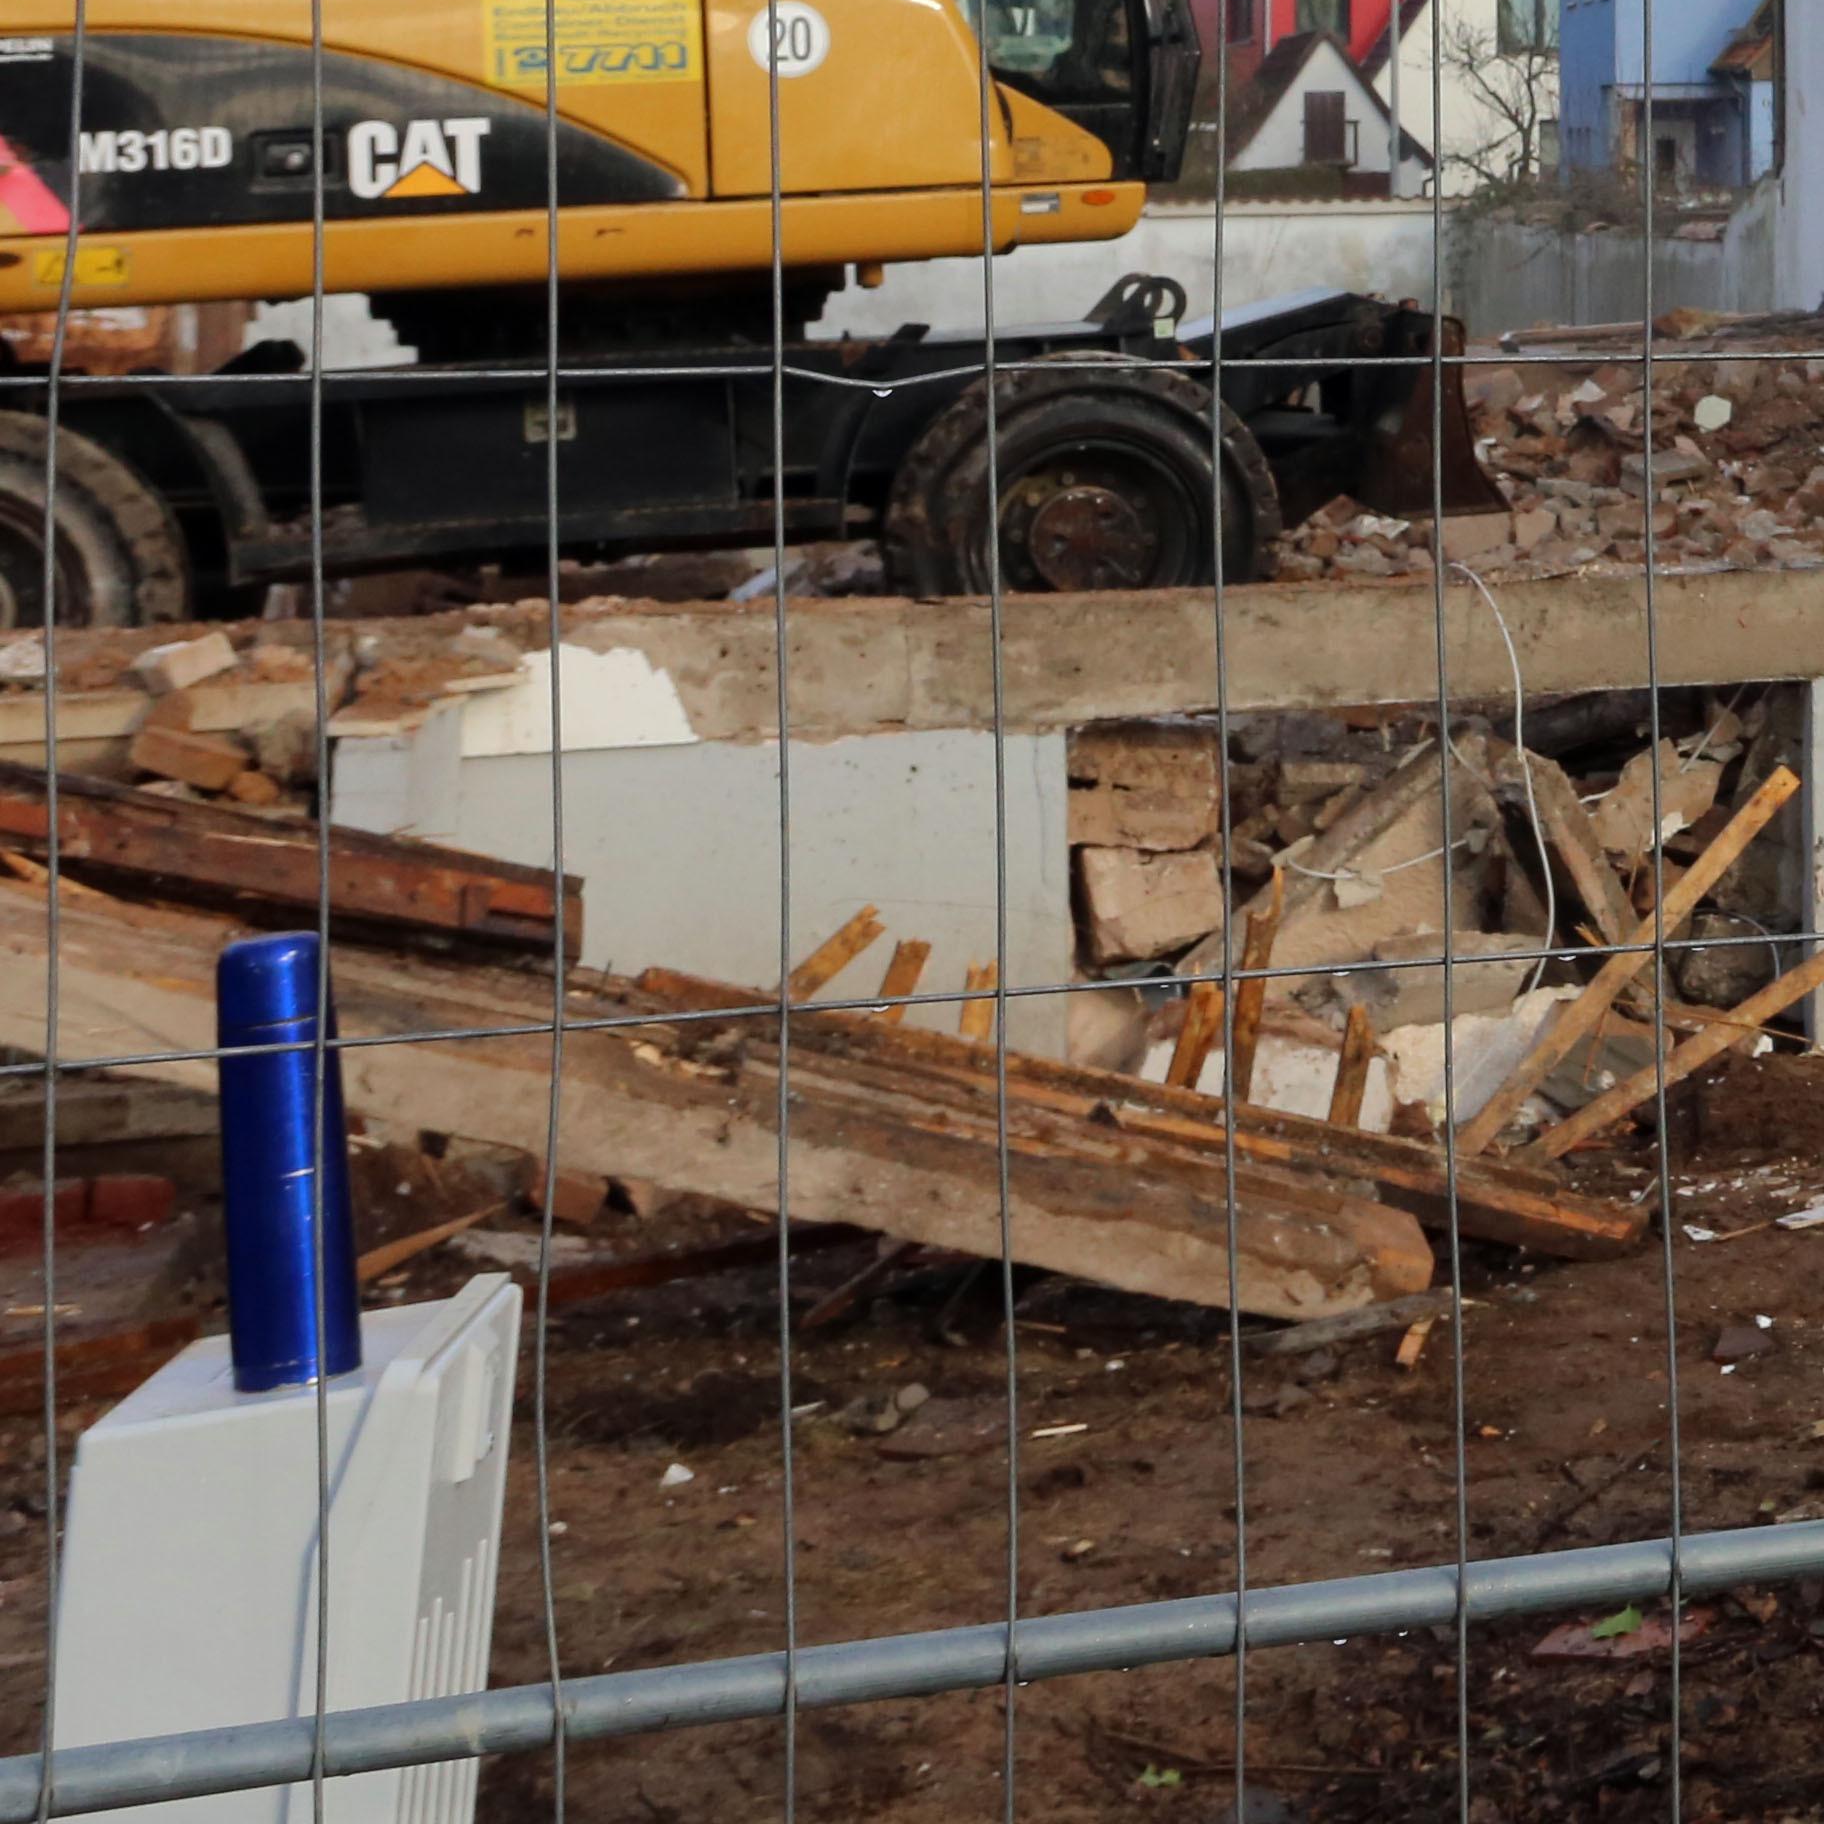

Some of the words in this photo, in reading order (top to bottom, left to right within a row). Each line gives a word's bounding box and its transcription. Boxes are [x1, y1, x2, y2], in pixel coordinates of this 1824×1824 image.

[767, 17, 811, 61] 20
[80, 127, 234, 173] M316D
[349, 117, 490, 199] CAT
